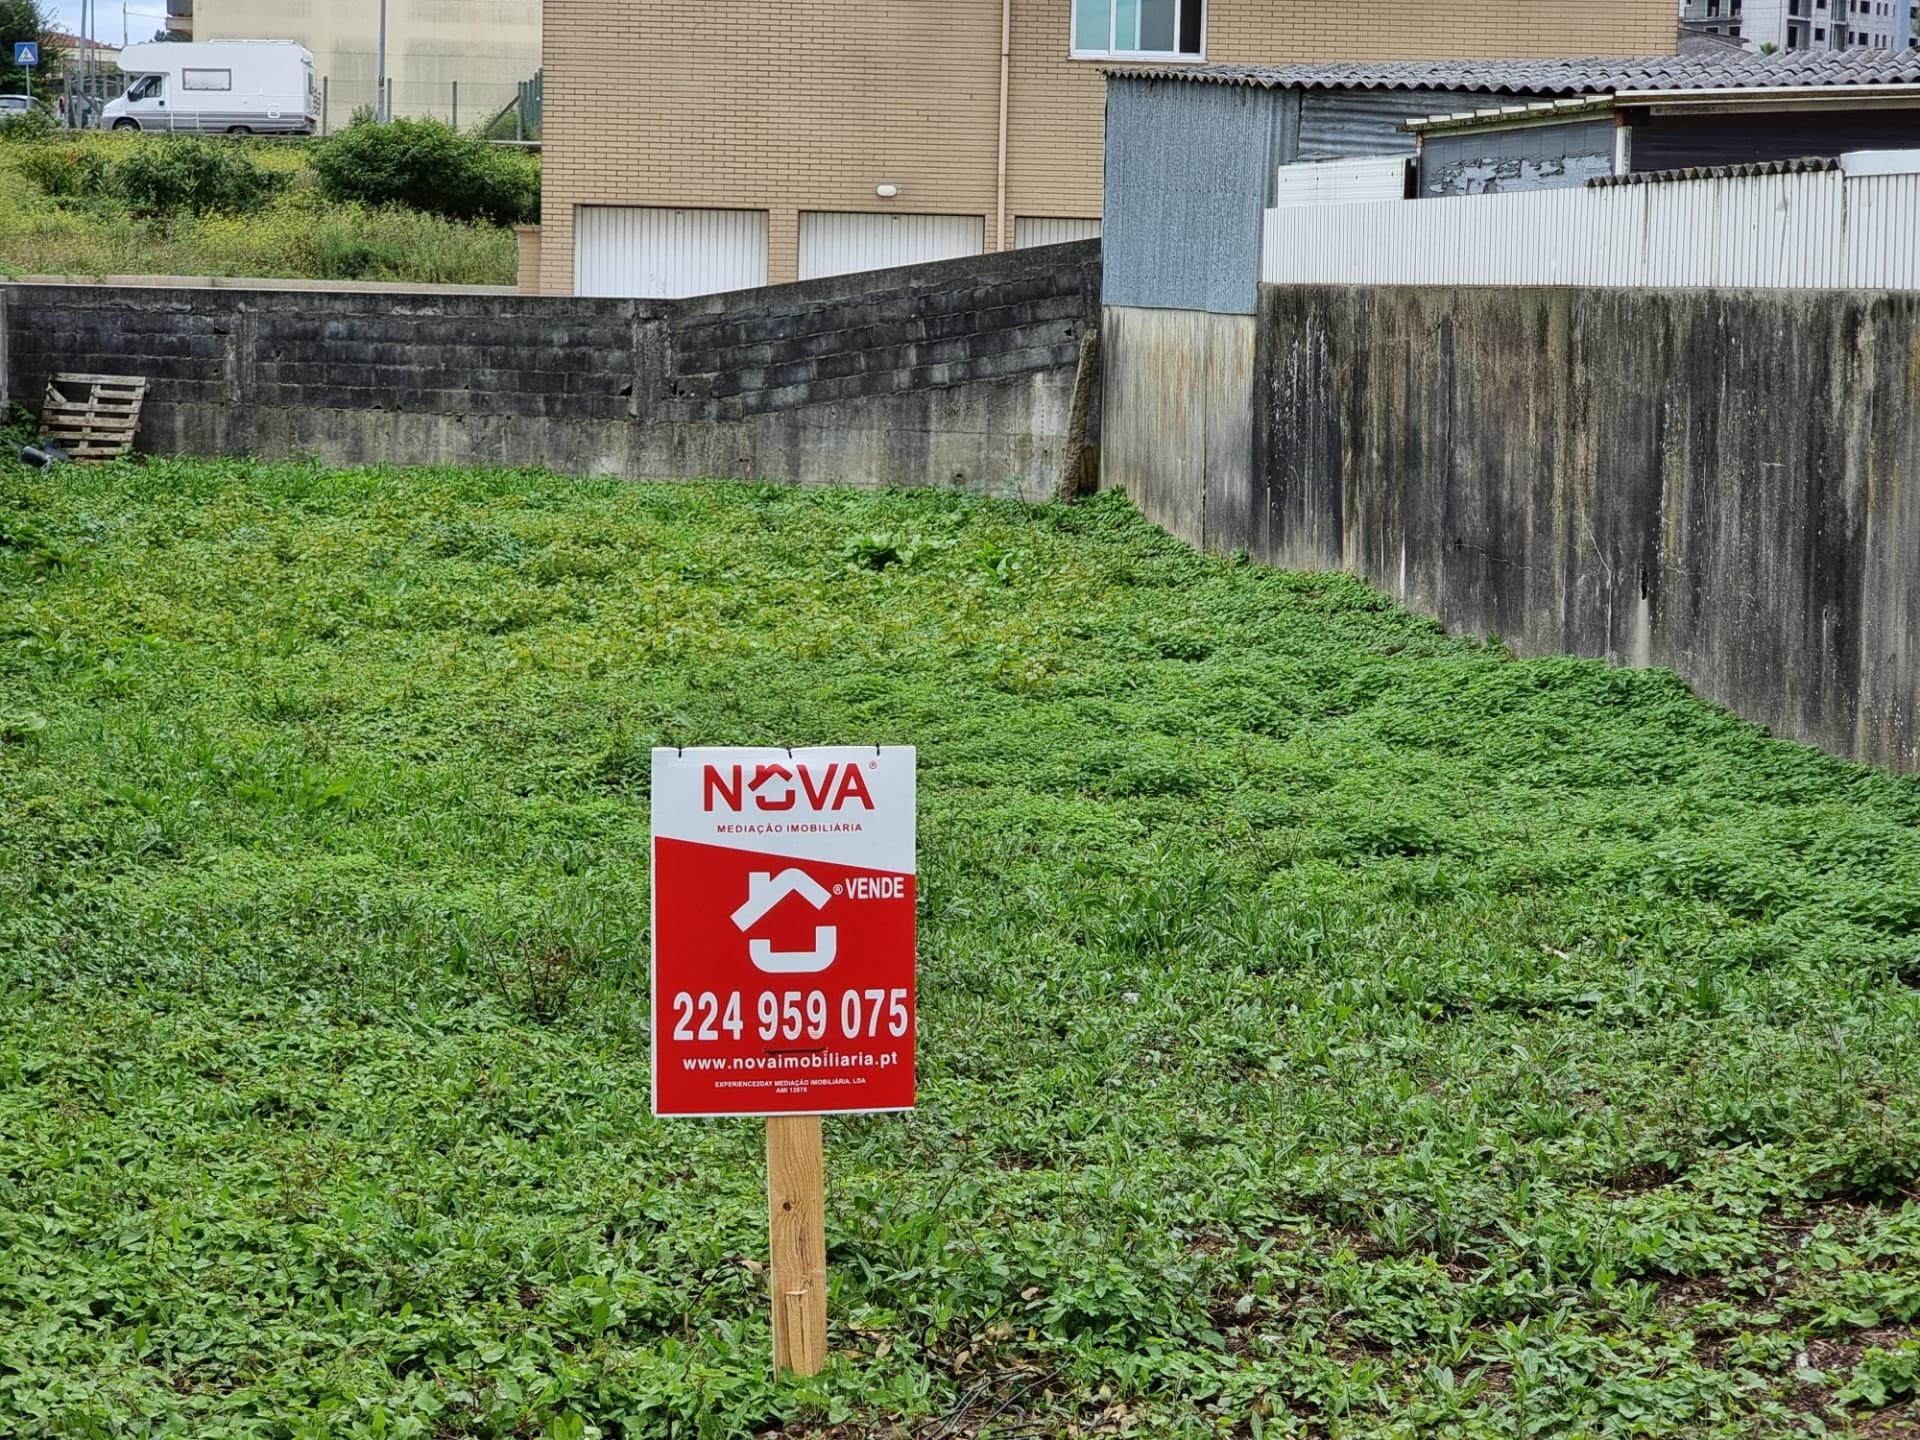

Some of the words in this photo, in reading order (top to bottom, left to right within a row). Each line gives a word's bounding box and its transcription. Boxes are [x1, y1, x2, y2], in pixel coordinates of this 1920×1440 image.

[703, 763, 876, 812] NOVA
[717, 822, 783, 835] MEDIAÇÃO
[786, 821, 863, 833] IMOBILIÁRIA
[845, 877, 905, 899] VENDE
[673, 991, 744, 1041] 224
[757, 990, 828, 1041] 959
[841, 988, 908, 1039] 075
[682, 1051, 898, 1070] www.novaimobiliaria.pt
[774, 1078, 809, 1087] MEDIAÇÃO
